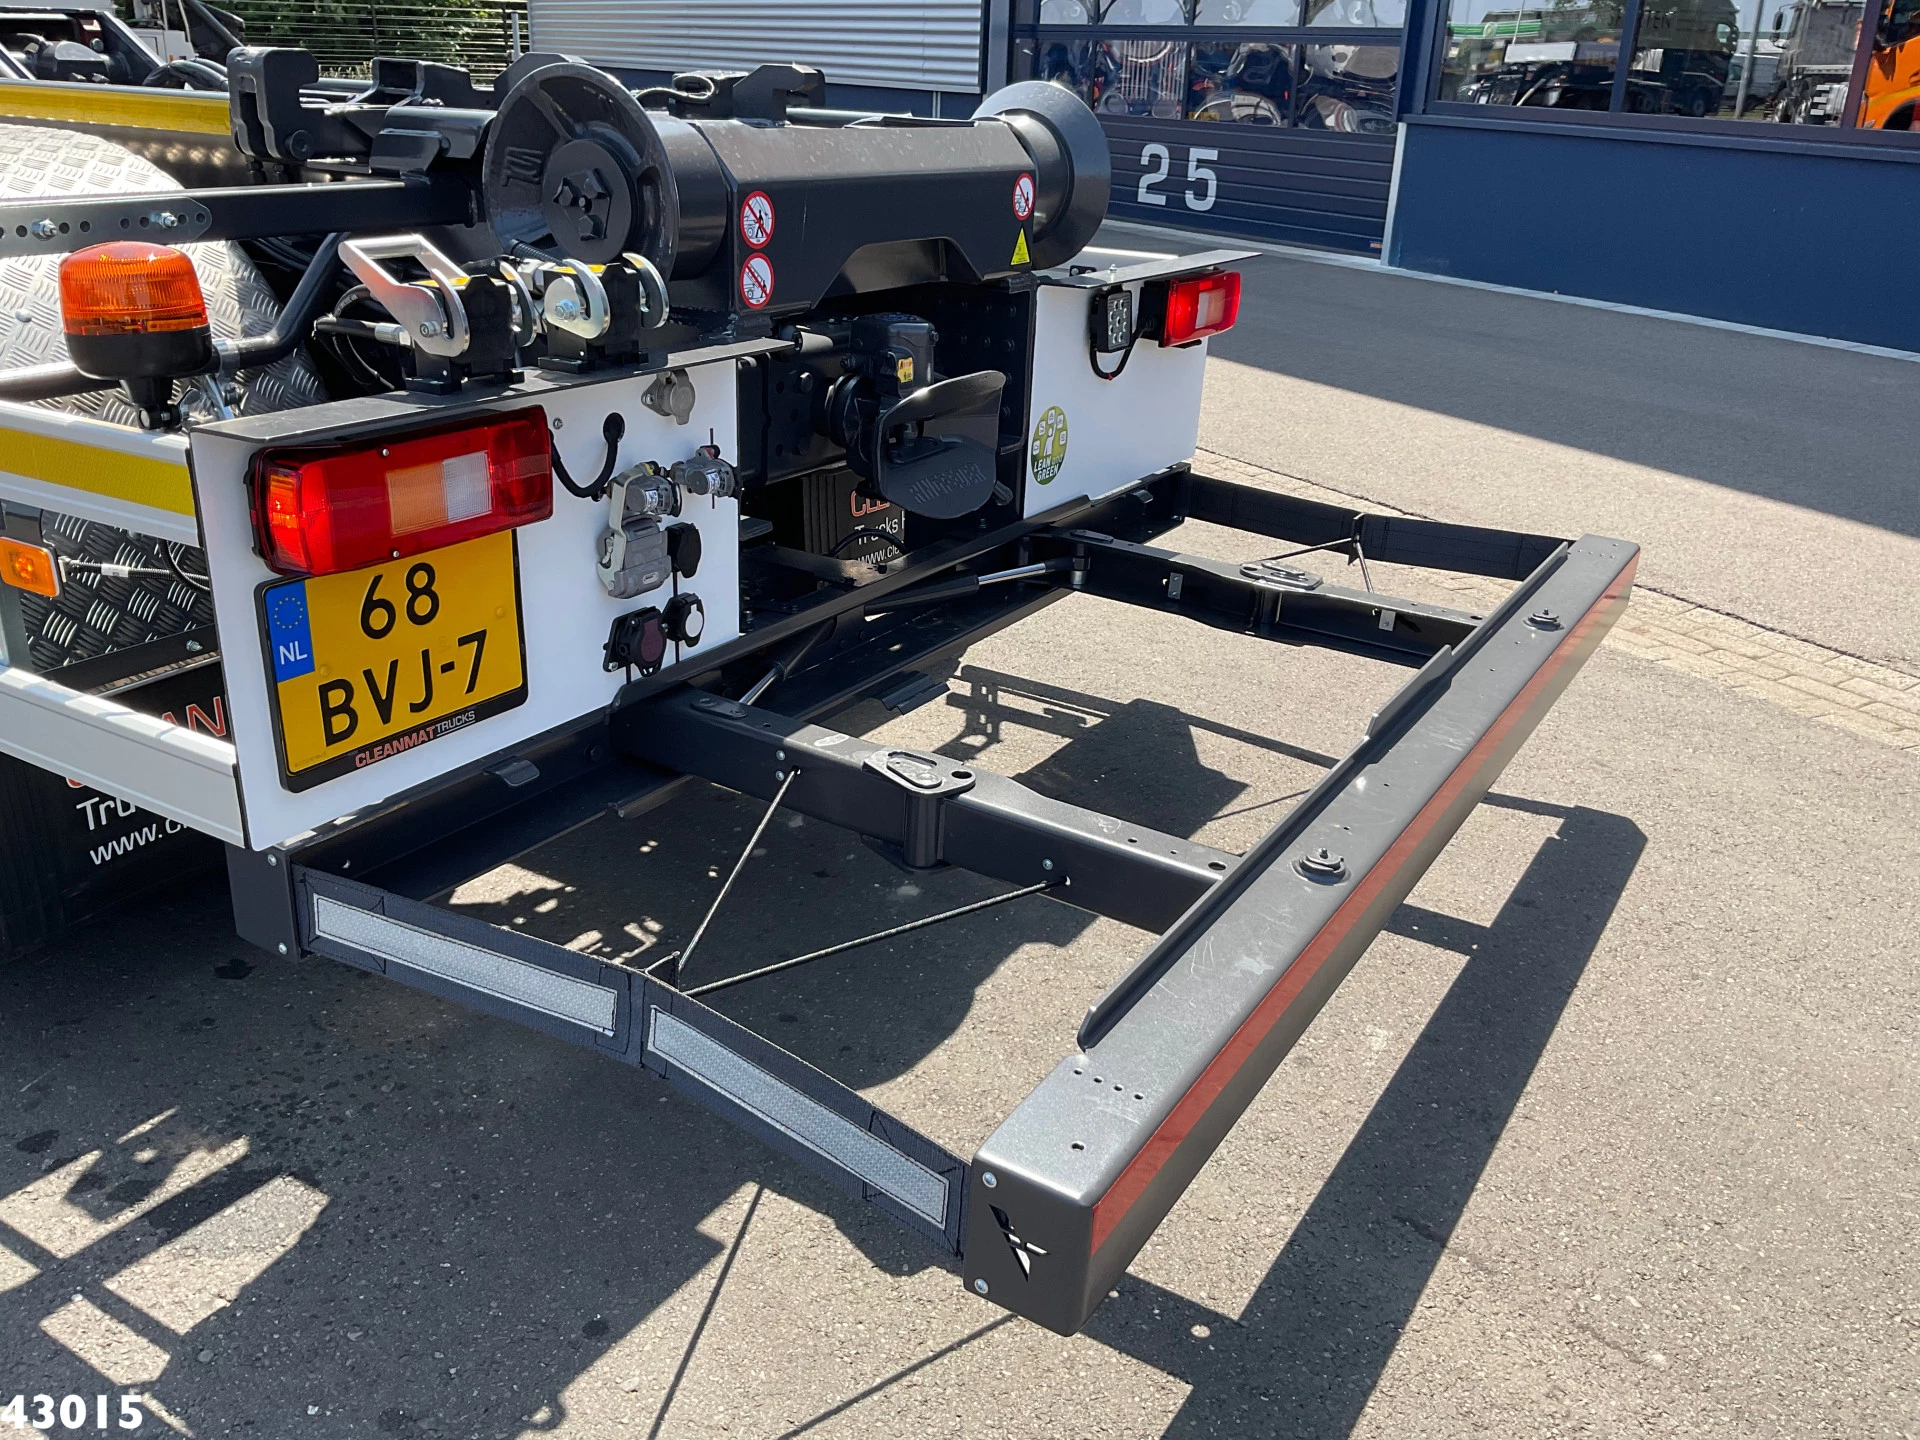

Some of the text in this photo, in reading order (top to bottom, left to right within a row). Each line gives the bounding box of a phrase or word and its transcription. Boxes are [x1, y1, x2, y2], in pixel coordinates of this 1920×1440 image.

[1137, 143, 1219, 211] 25
[1034, 456, 1052, 473] LEAN
[1037, 463, 1059, 482] GREEN
[360, 562, 440, 640] 68
[279, 640, 308, 666] NL
[317, 628, 488, 748] BVJ-7
[89, 817, 188, 866] www.c
